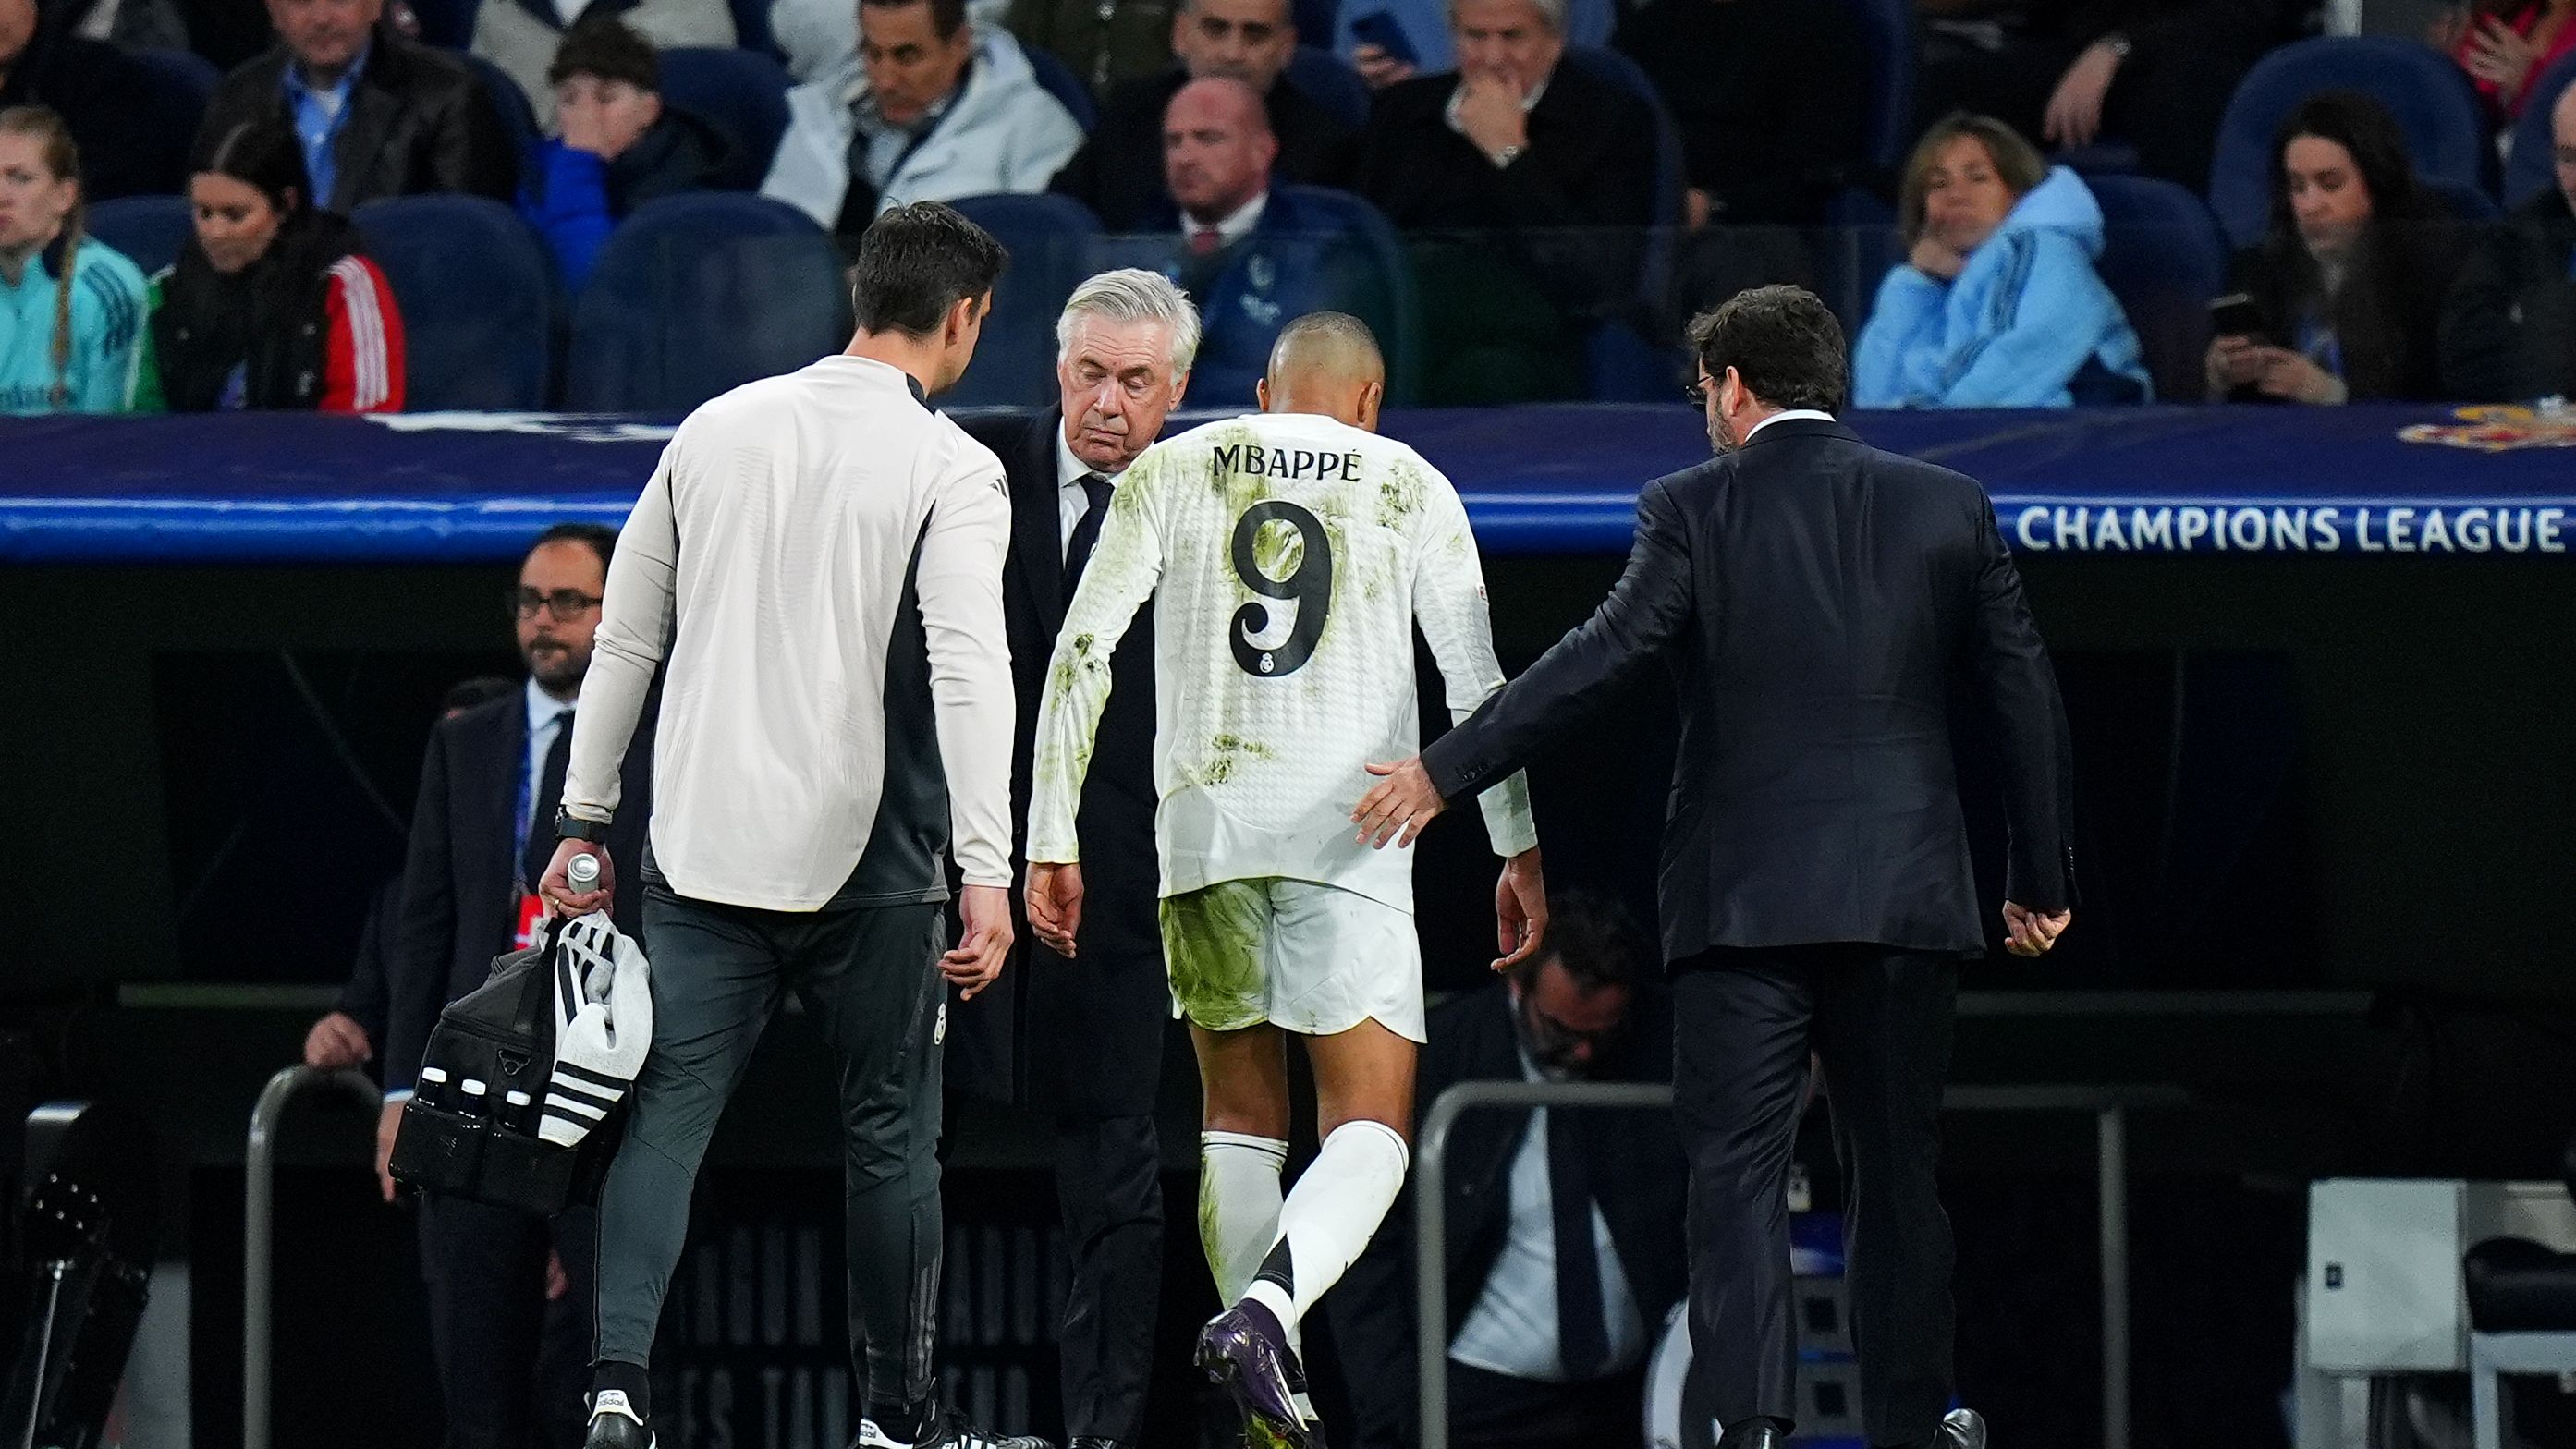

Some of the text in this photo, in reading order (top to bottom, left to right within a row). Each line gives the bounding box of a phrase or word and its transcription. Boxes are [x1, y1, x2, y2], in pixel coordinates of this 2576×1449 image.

[1213, 444, 1362, 482] MBAPPÉ
[2016, 505, 2566, 553] CHAMPIONS LEAGUE
[1229, 500, 1332, 677] 9
